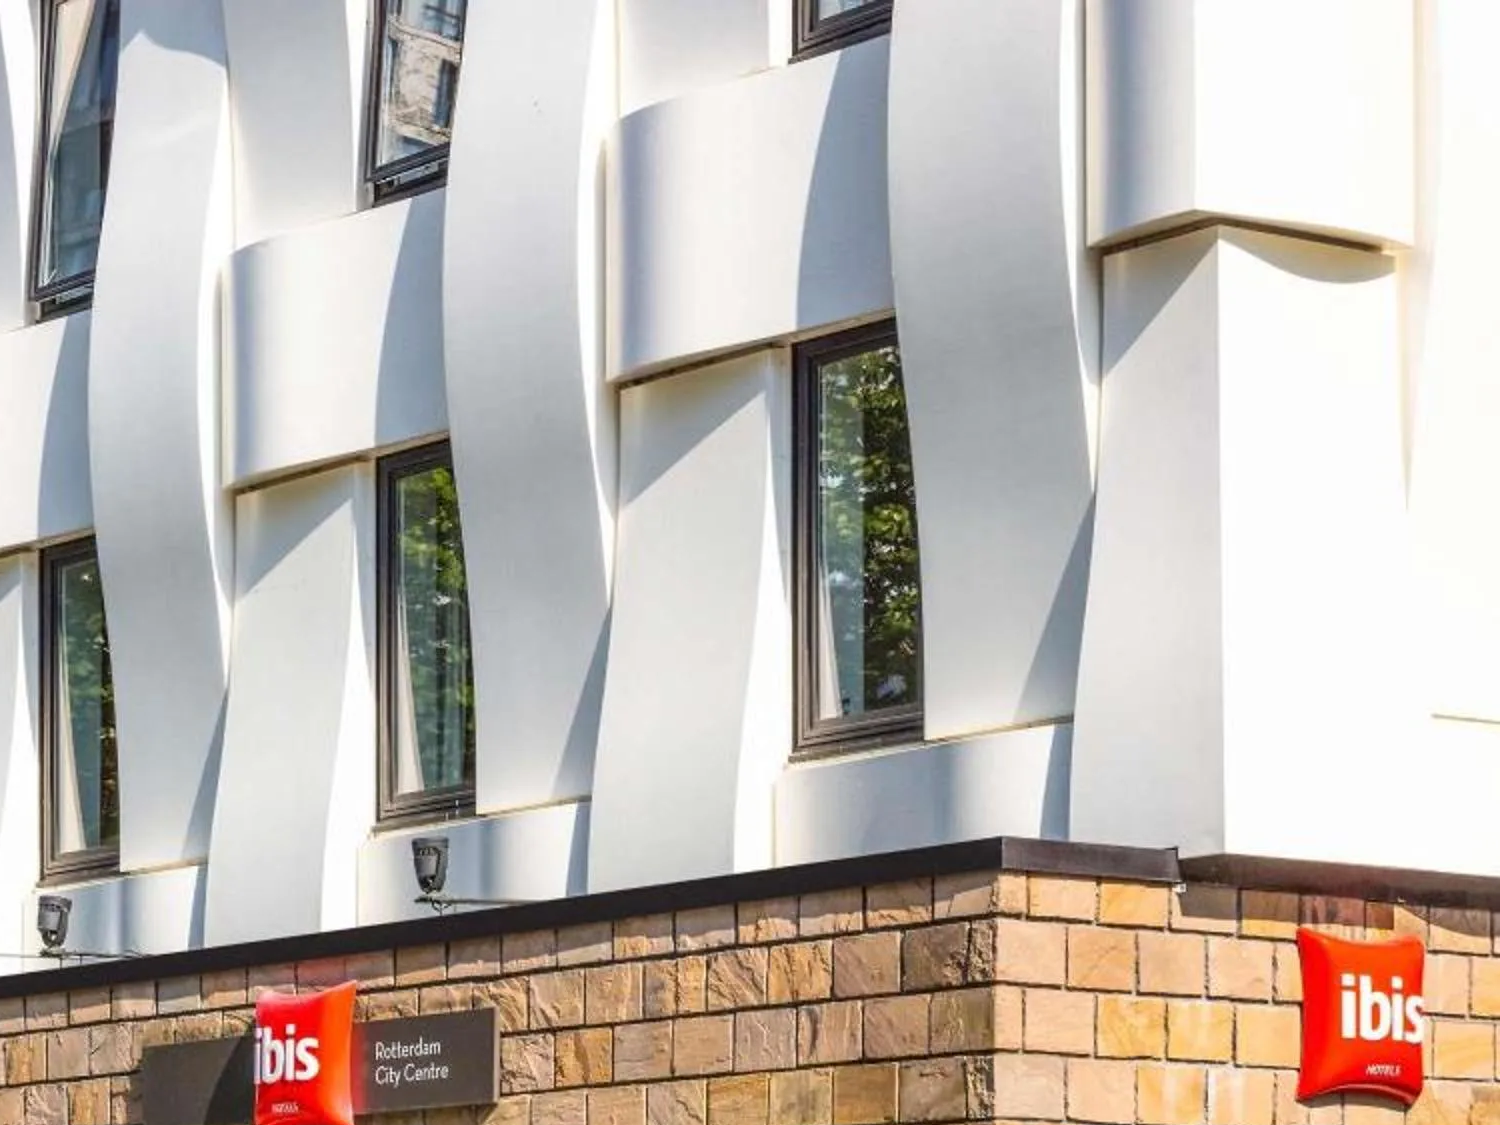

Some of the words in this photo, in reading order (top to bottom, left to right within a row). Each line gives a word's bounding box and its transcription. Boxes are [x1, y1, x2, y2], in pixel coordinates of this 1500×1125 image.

[1340, 973, 1425, 1044] ibis
[254, 1023, 321, 1085] ibis
[375, 1035, 441, 1060] Rotterdam
[375, 1065, 401, 1089] City
[403, 1062, 449, 1082] Centre
